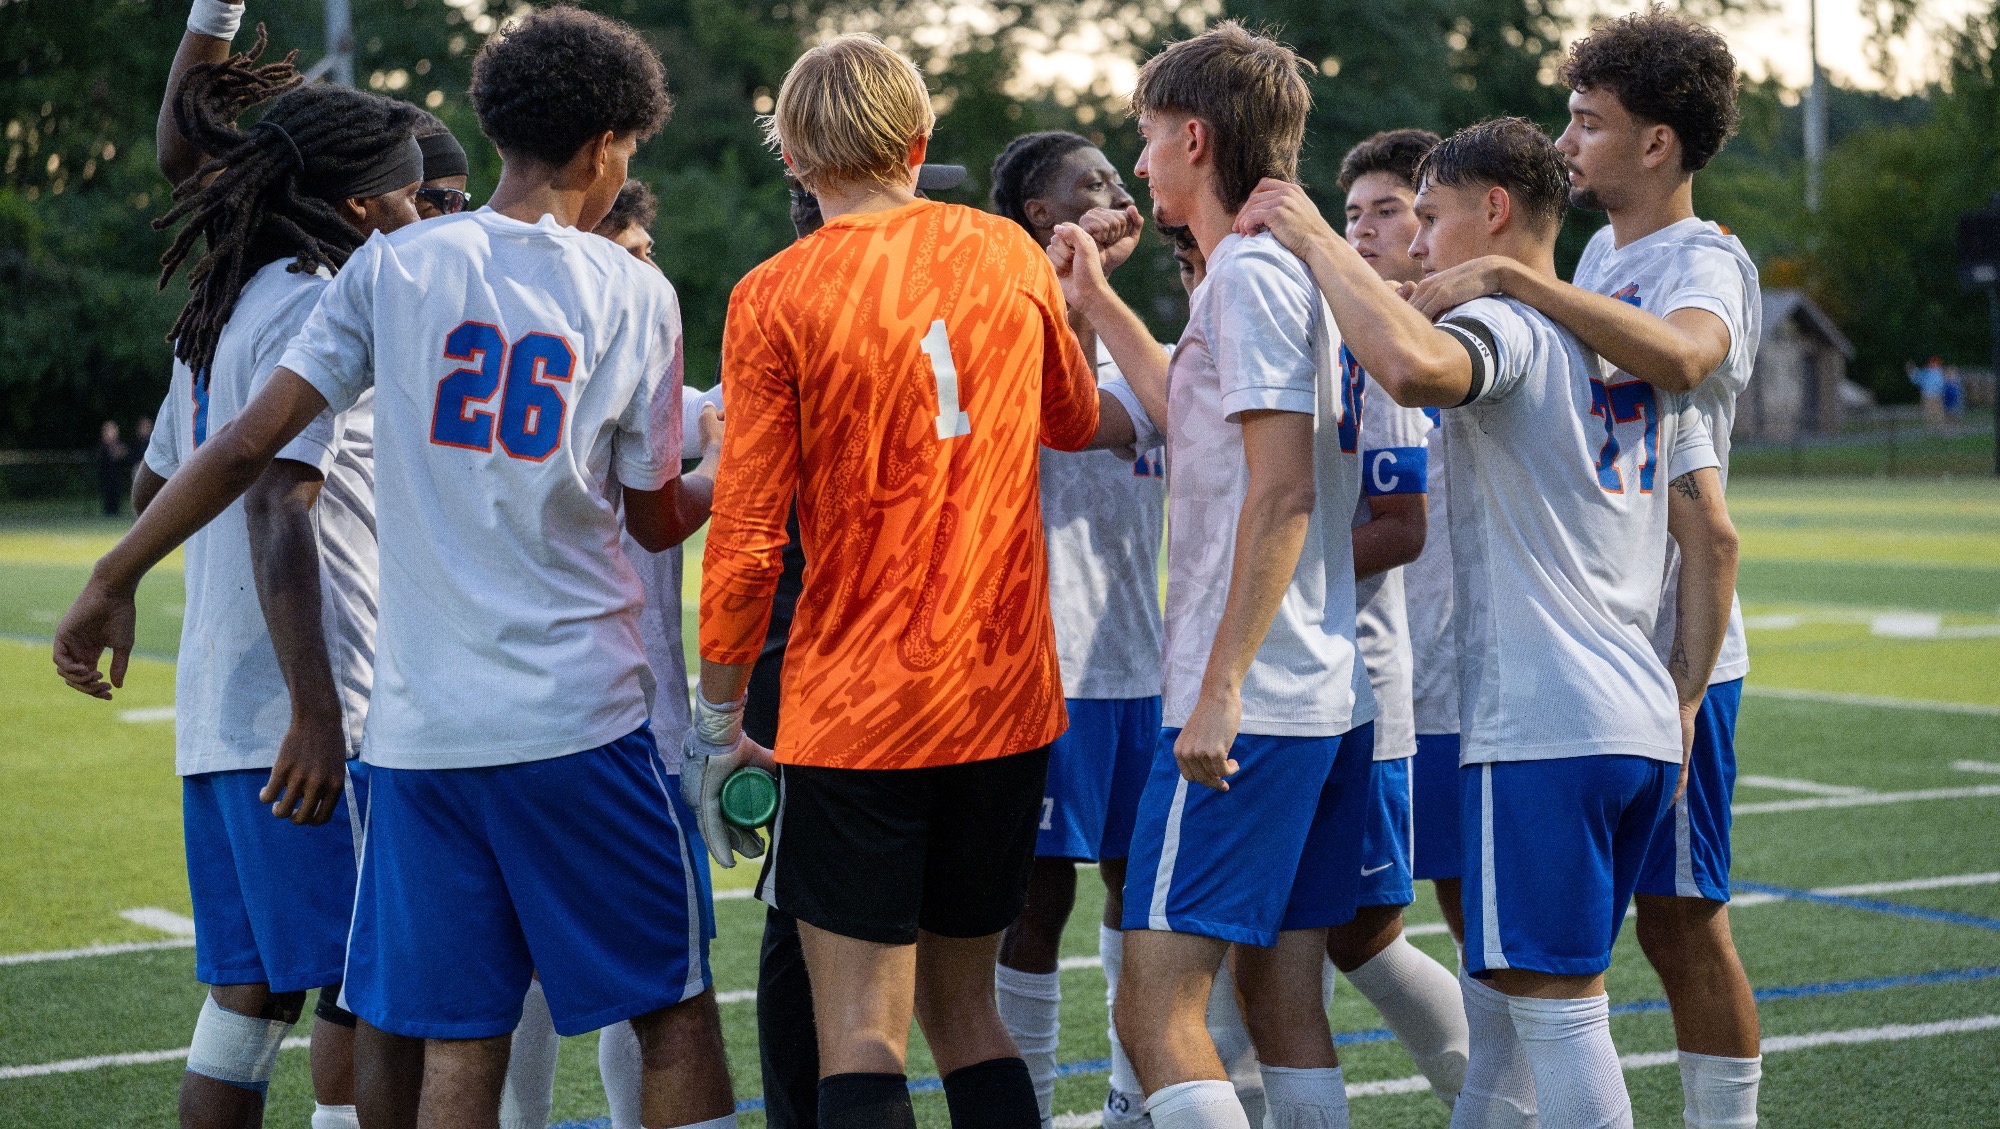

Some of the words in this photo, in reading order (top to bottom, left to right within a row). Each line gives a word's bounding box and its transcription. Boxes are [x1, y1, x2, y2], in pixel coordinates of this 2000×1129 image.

[430, 320, 577, 464] 26
[920, 319, 971, 440] 1
[1589, 377, 1660, 494] 77
[1372, 451, 1400, 492] C
